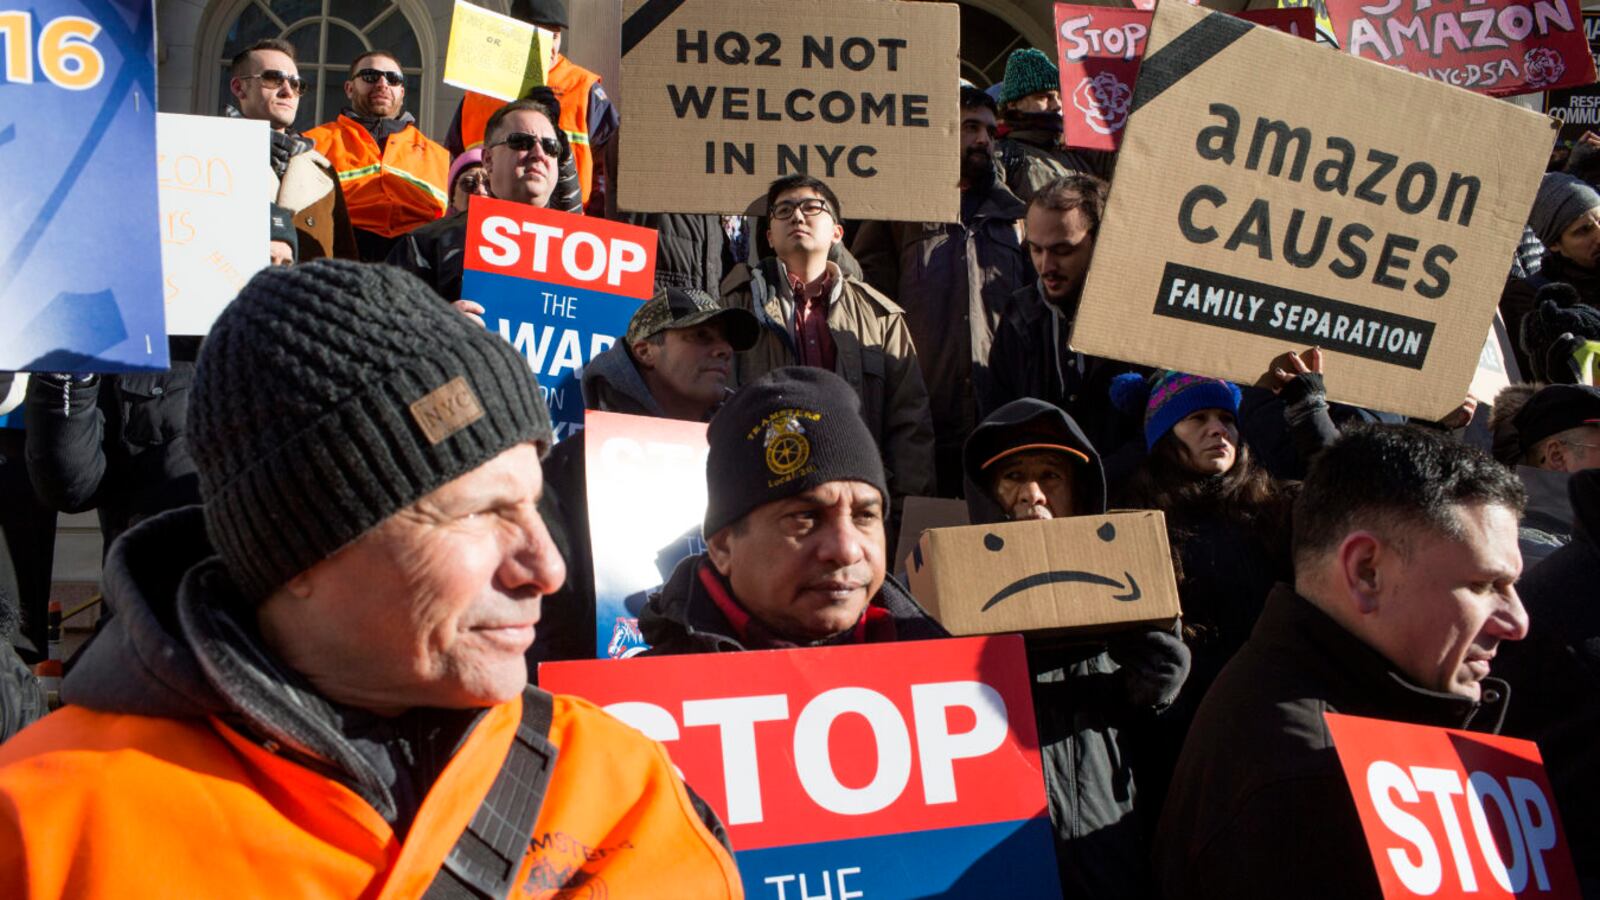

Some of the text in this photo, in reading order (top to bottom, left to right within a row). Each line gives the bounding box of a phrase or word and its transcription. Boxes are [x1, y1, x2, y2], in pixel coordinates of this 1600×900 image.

[676, 29, 907, 72] HQ2 NOT
[1061, 15, 1147, 61] STOP
[1351, 0, 1575, 60] AMAZON
[667, 85, 930, 127] WELCOME
[706, 141, 878, 178] IN NYC
[1196, 102, 1482, 228] amazon
[479, 216, 647, 287] STOP
[1178, 185, 1459, 299] CAUSES
[541, 292, 578, 319] THE
[1167, 278, 1423, 356] FAMILY SEPARATION
[422, 392, 472, 429] NYC
[1367, 760, 1557, 896] STOP
